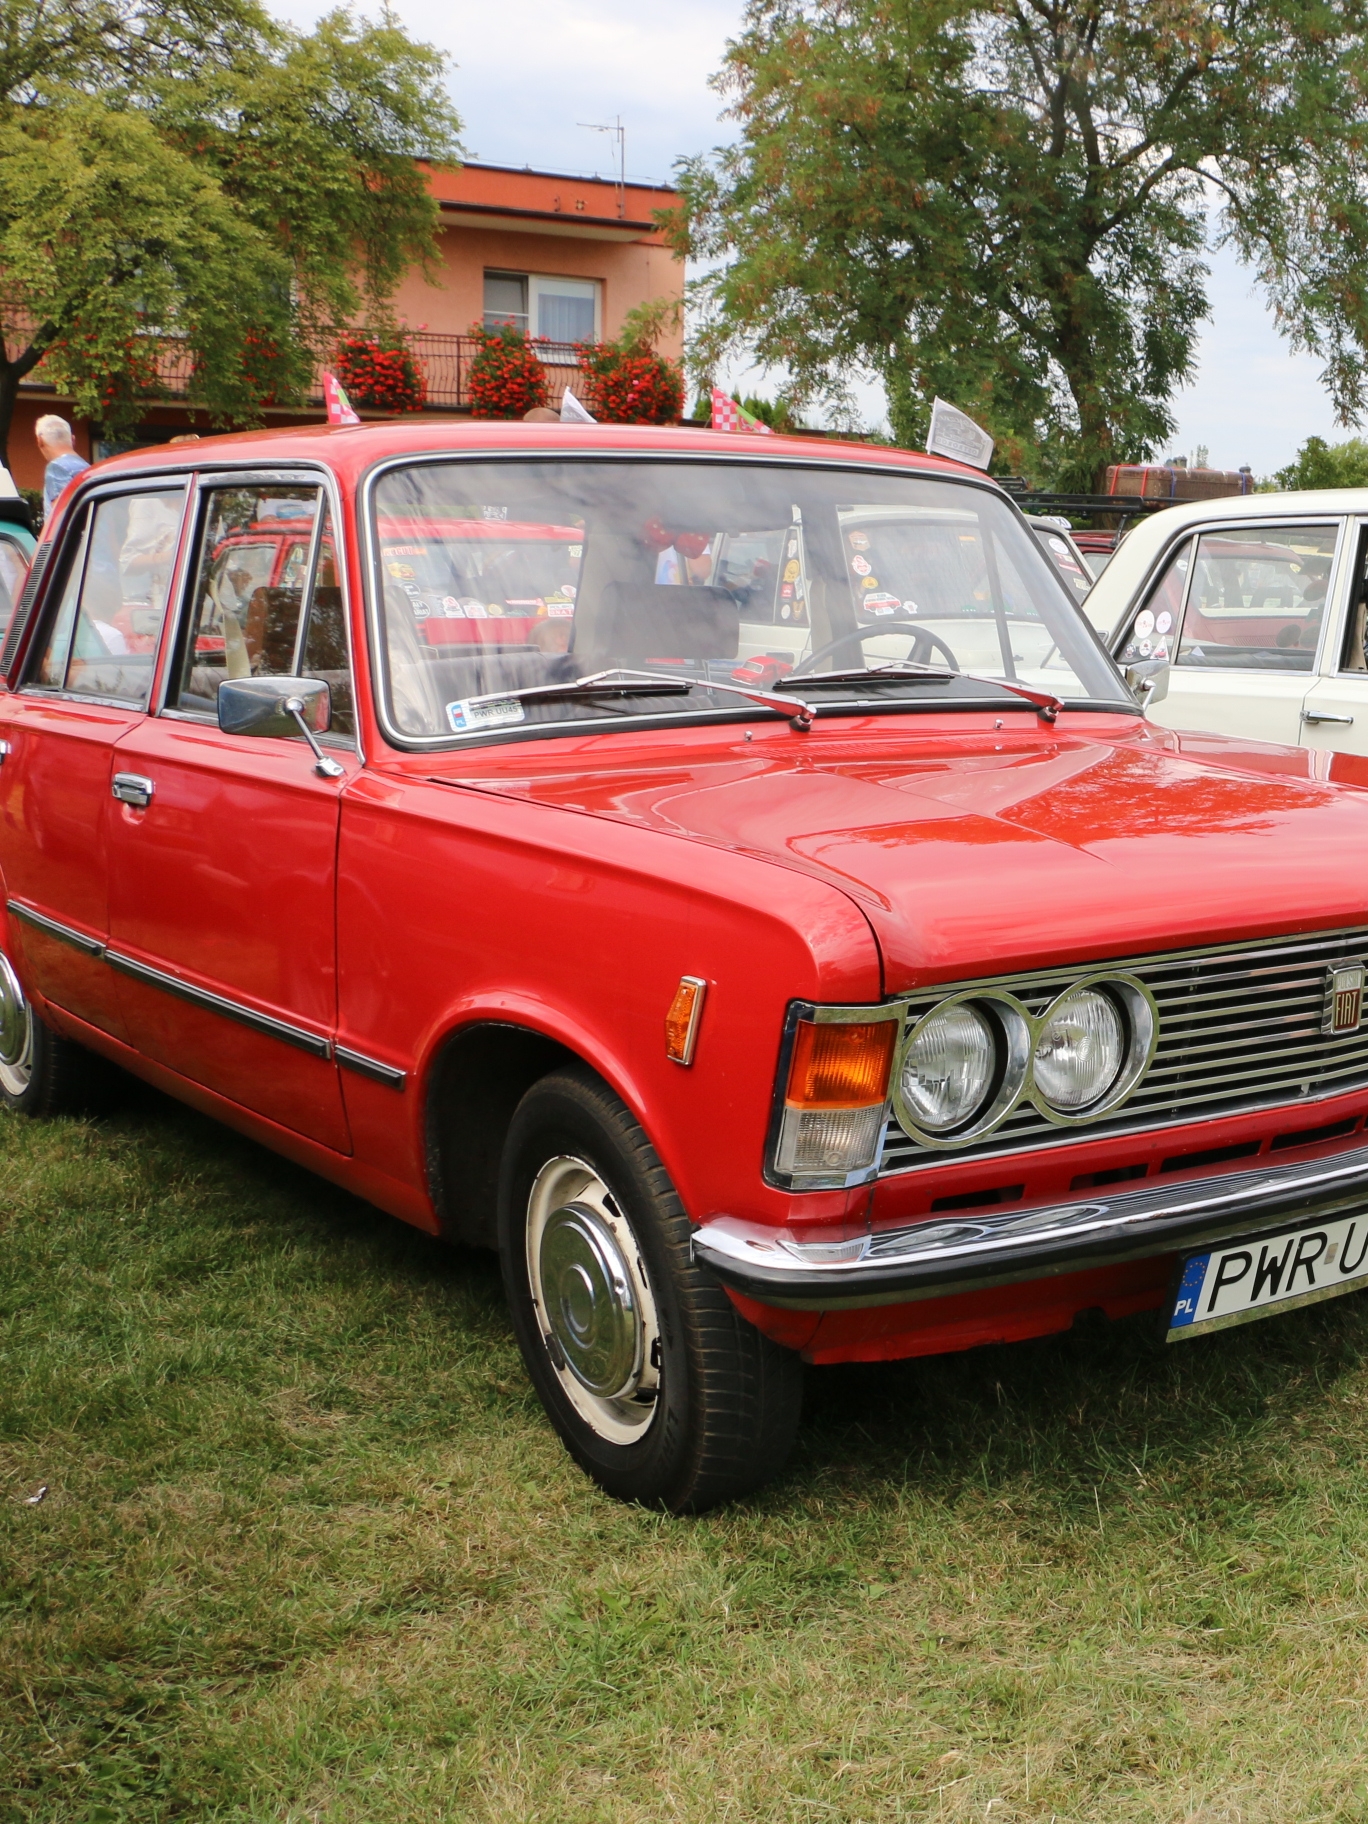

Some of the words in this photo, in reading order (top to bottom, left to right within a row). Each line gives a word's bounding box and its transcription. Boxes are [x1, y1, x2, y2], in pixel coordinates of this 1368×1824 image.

[474, 709, 494, 718] PWR
[496, 706, 518, 715] UU45
[1335, 991, 1358, 1027] FIAT
[1173, 1297, 1194, 1317] PL
[1206, 1231, 1329, 1313] PWR
